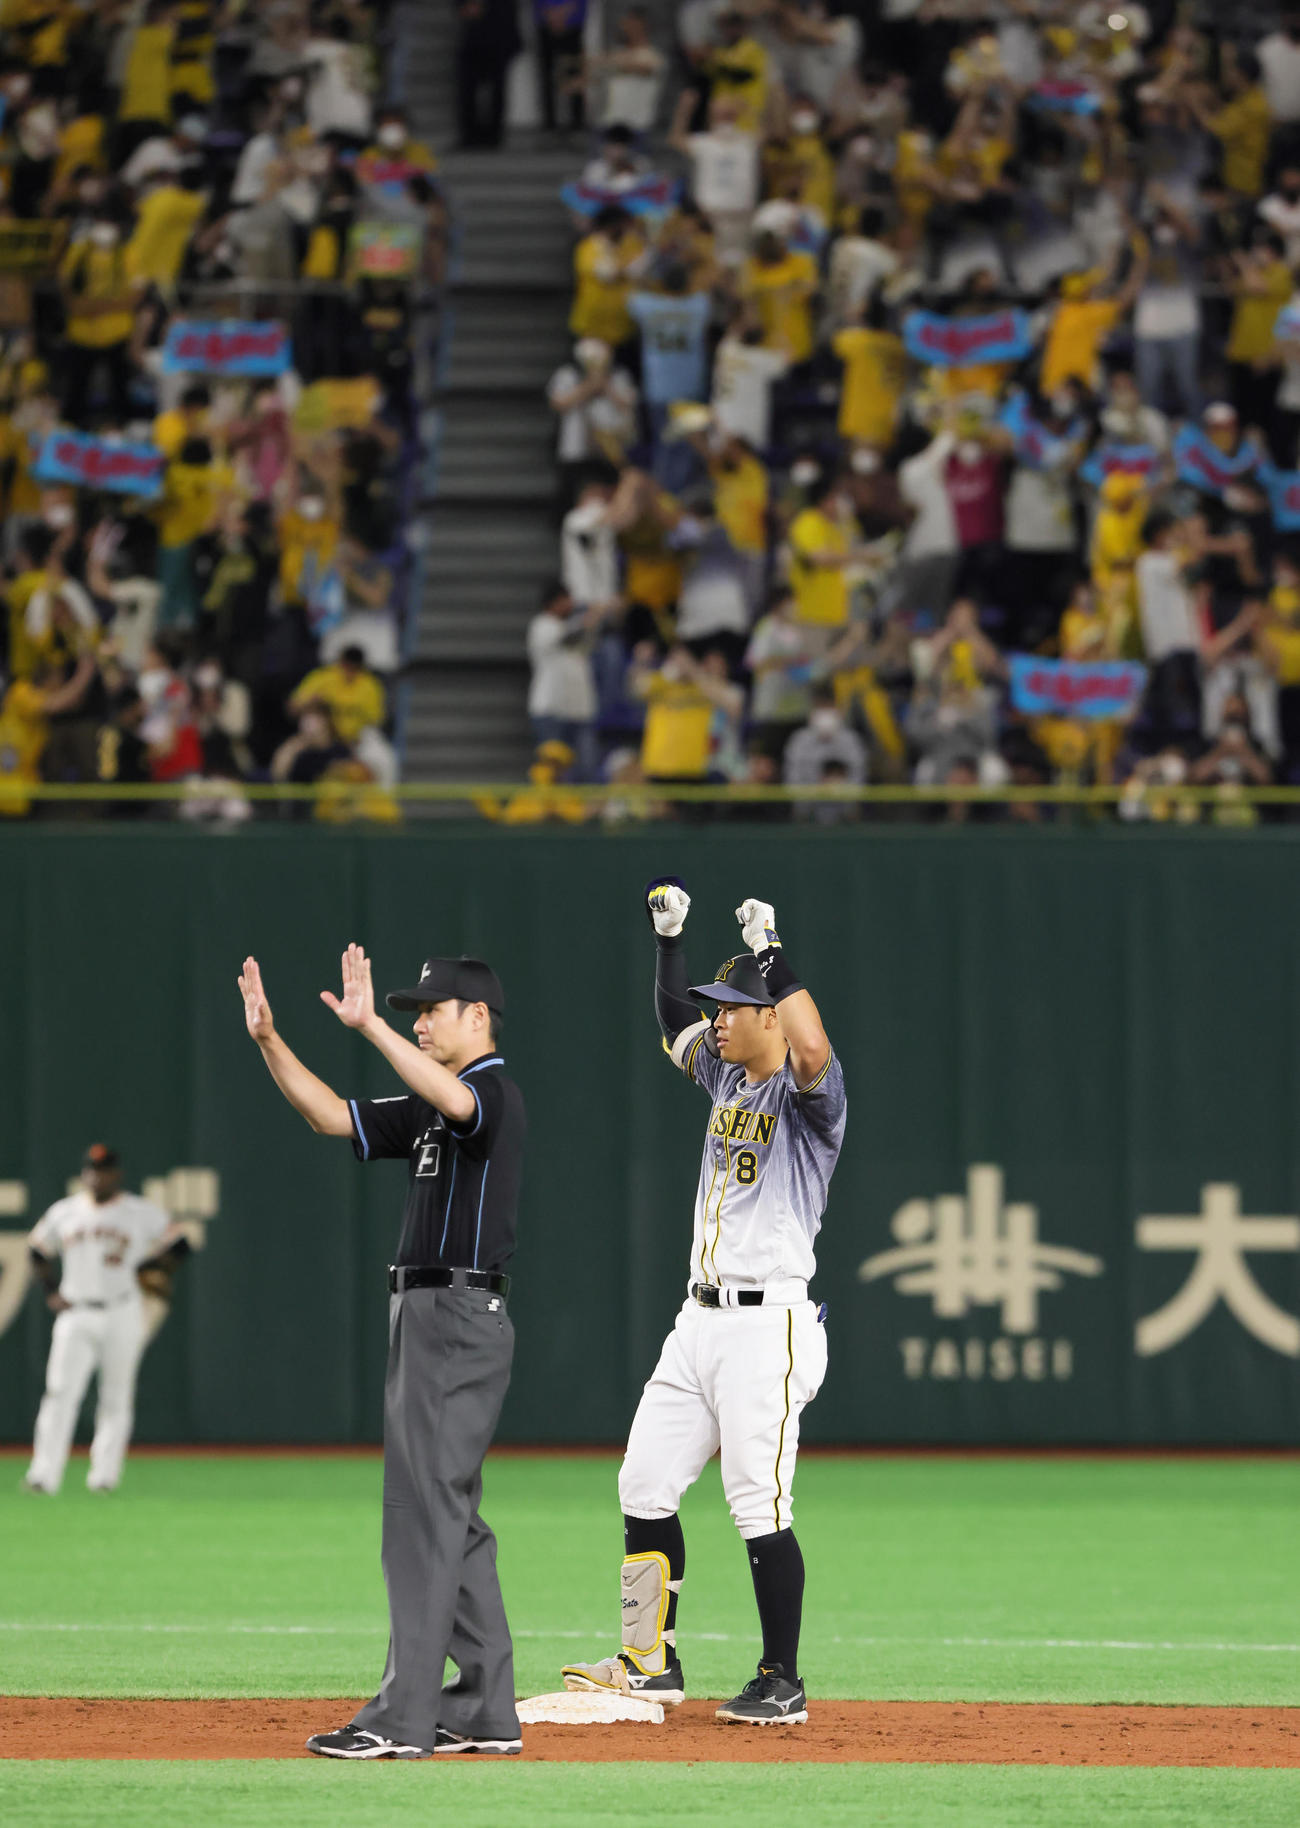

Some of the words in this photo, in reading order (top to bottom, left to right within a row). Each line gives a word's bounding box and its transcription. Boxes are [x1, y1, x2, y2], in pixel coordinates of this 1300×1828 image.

[709, 1107, 777, 1146] SHIN
[736, 1150, 758, 1186] 8
[1135, 1182, 1300, 1358] 大
[902, 1337, 1073, 1381] TAISEI
[620, 1598, 639, 1608] Sato
